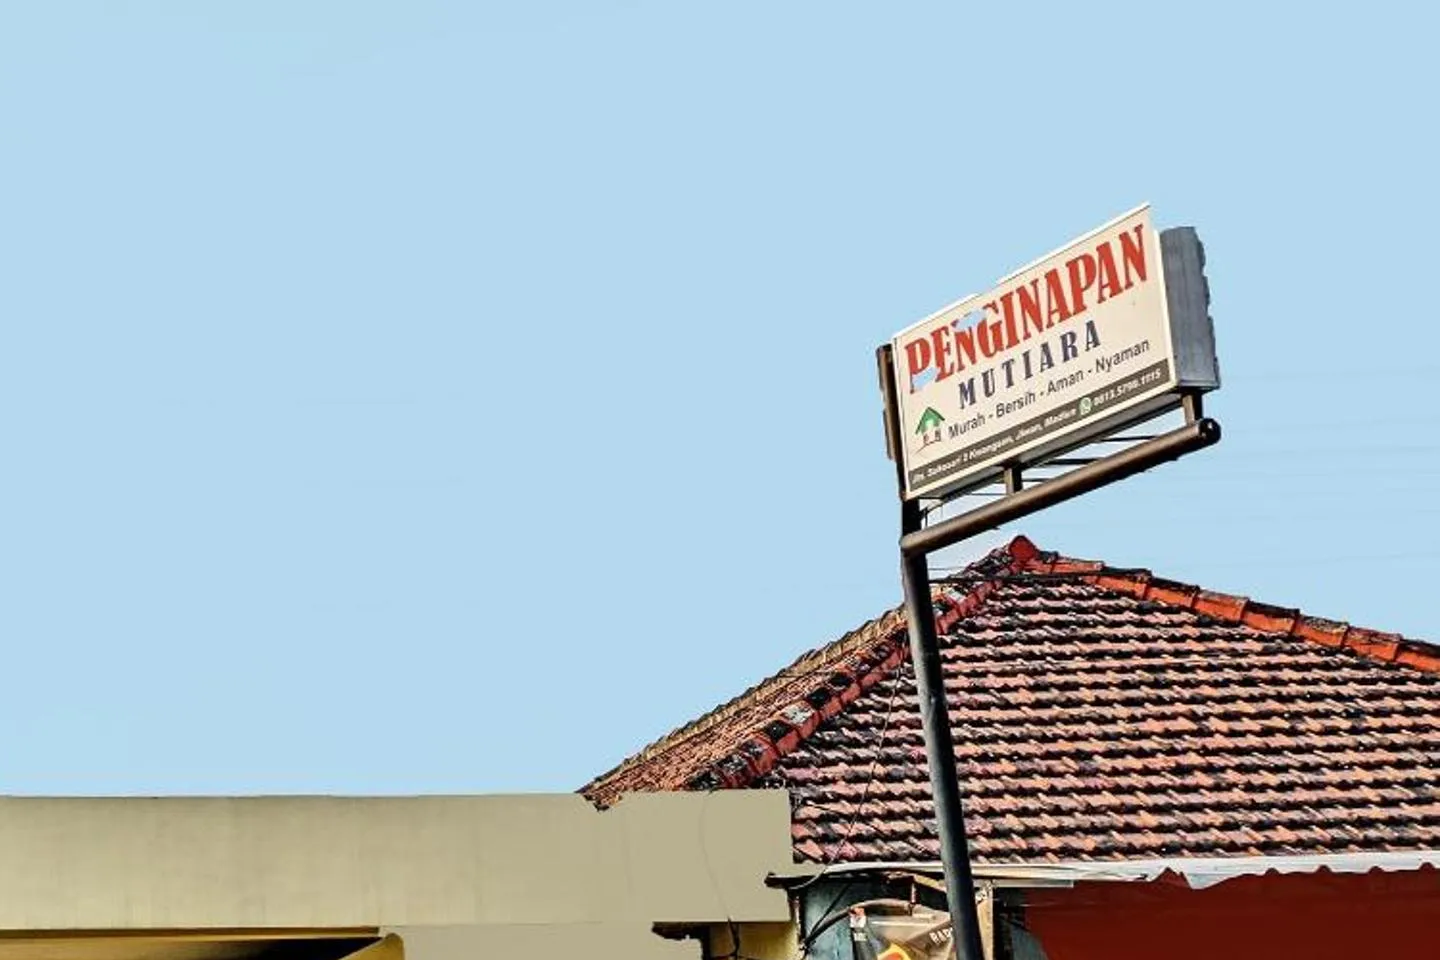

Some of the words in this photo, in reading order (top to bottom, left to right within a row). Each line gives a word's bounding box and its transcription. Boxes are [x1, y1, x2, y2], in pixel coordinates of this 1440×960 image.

[905, 223, 1147, 394] PENGINAPAN
[948, 413, 986, 441] Murah
[996, 391, 1036, 418] Bersih
[1046, 370, 1084, 398] Aman
[1095, 339, 1150, 375] Nyaman
[958, 320, 1101, 409] MUTIARA
